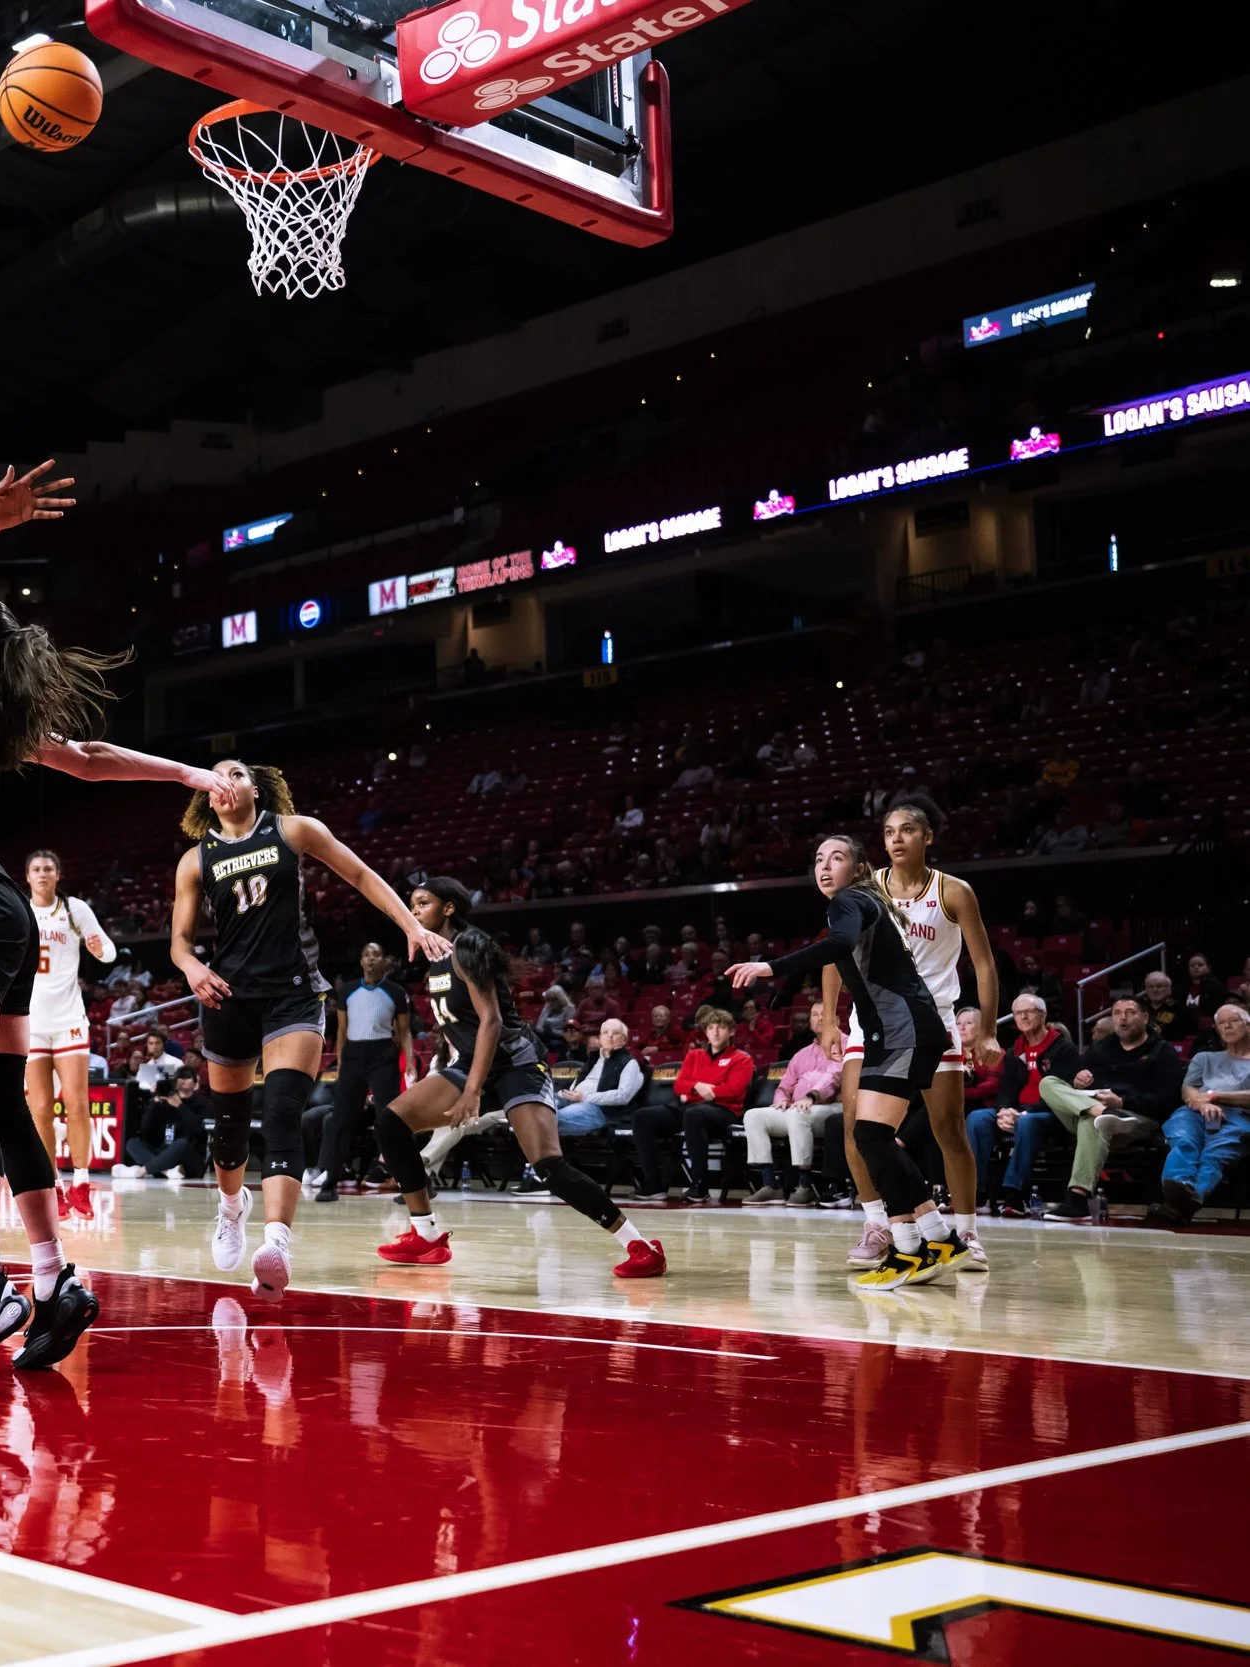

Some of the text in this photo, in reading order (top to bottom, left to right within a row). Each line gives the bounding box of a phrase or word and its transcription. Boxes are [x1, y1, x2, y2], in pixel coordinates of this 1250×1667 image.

[507, 0, 618, 49] Sta
[543, 5, 706, 78] State
[23, 104, 82, 144] Wilson
[1104, 379, 1250, 437] LOGAN'S SAUSA
[828, 447, 970, 501] LOGAN'S SAUSAGE
[604, 506, 722, 553] LOGAN'S SAUSAGE
[456, 560, 491, 577] HOME
[491, 555, 507, 571] OF
[456, 563, 535, 593] TERRAPINS
[379, 582, 397, 609] M
[231, 616, 247, 642] M
[211, 845, 280, 882] RETRIEVERS
[232, 873, 269, 914] 10
[908, 922, 936, 942] AND
[1186, 994, 1201, 1007] M
[70, 1028, 82, 1037] M
